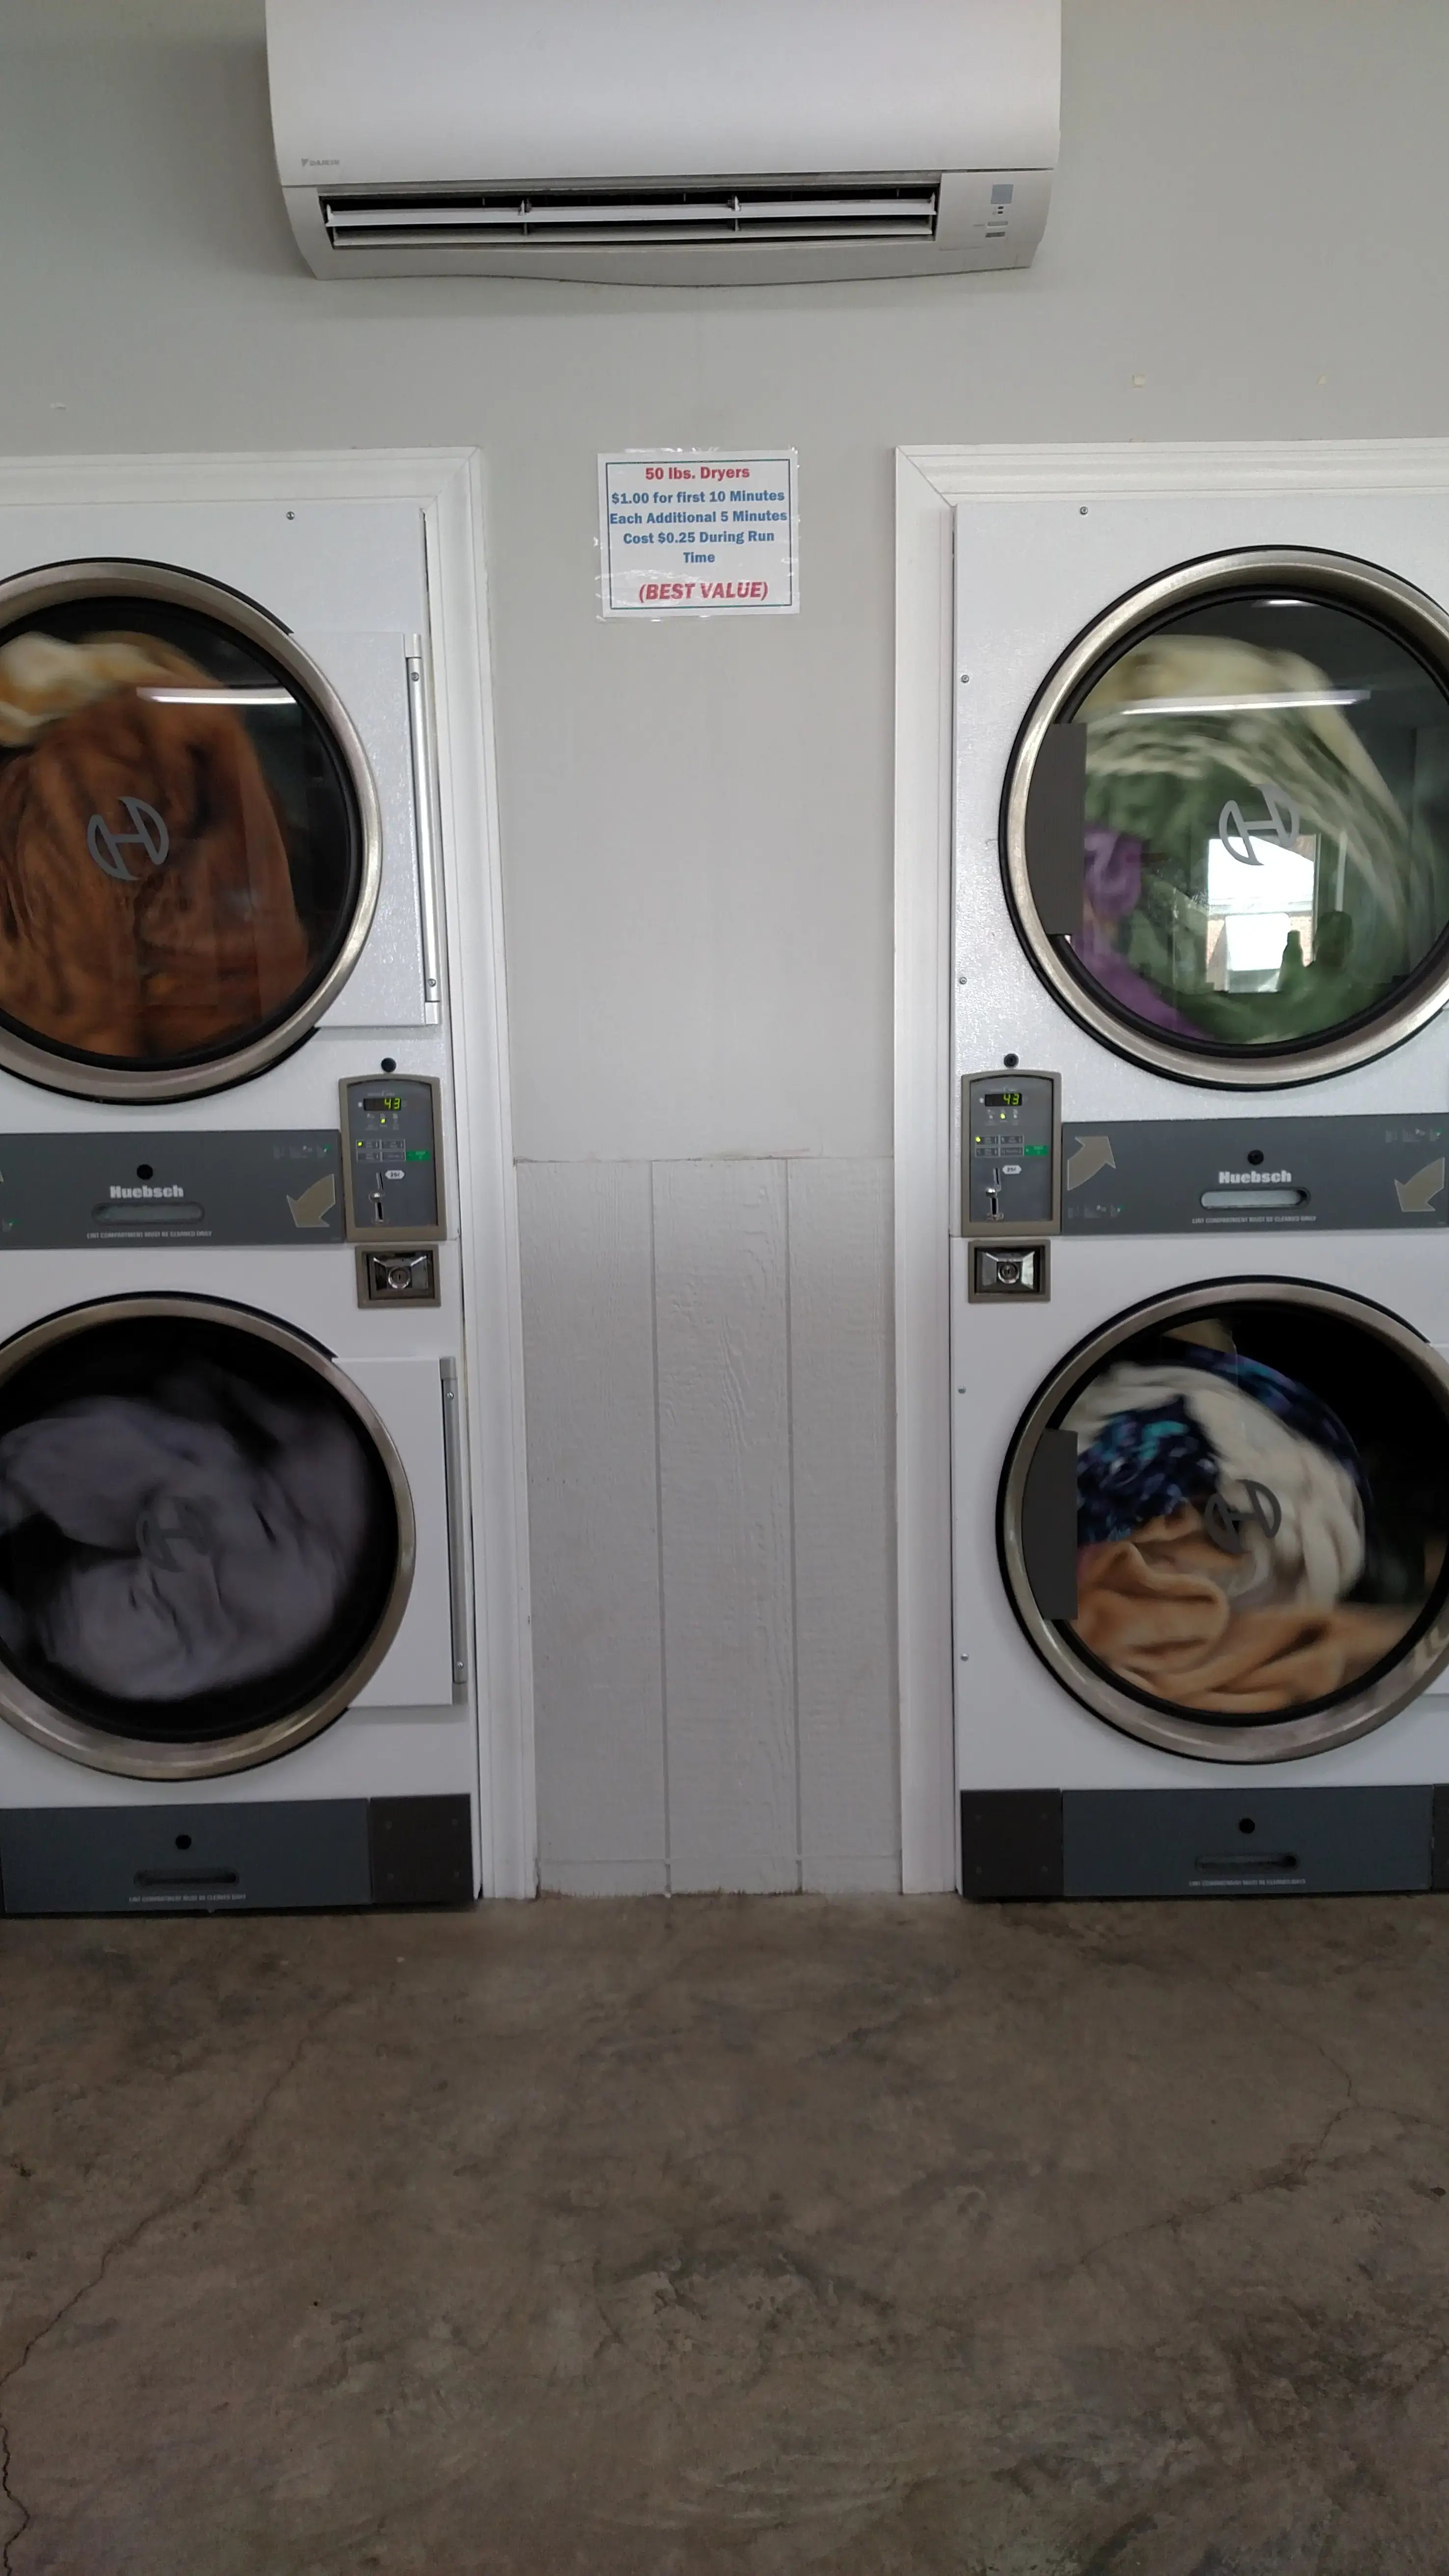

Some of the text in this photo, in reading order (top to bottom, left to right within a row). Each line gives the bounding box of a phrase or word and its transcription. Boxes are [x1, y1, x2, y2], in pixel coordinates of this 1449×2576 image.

[645, 467, 750, 481] 50 lbs. Dryers
[612, 490, 784, 504] $1.00 for first 10 Minutes
[610, 510, 787, 524] Each Additional 5 Minutes
[623, 531, 775, 544] Cost $0.25 During Run
[683, 552, 715, 563] Time
[639, 582, 768, 603] (BEST VALUE)
[384, 1098, 401, 1109] 43
[1003, 1093, 1020, 1105] 43
[1218, 1170, 1292, 1184] Huebsch
[109, 1185, 184, 1199] Huebsch
